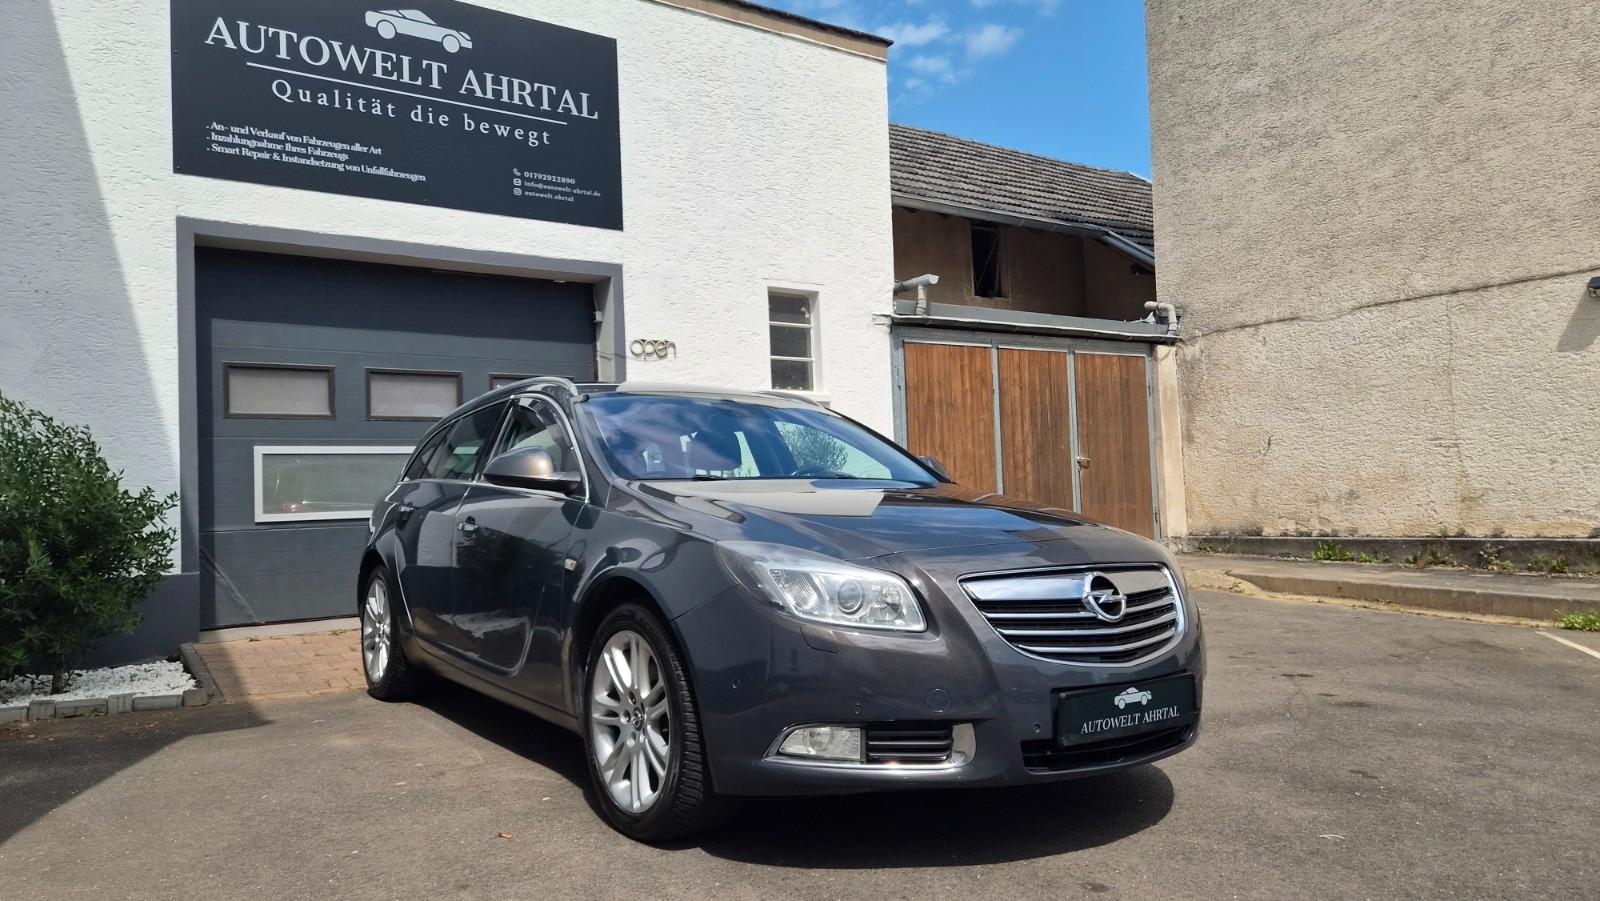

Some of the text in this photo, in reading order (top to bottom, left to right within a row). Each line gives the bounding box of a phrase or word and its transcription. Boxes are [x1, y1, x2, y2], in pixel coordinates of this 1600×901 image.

[205, 17, 599, 120] AUTOWELT AHRTAL
[271, 79, 550, 147] Qualität die bewegt
[210, 131, 349, 161] Inzahlungnahme Ihres Fahrzeugs
[230, 126, 249, 135] und
[249, 127, 287, 140] Verkauf
[286, 134, 302, 143] von
[302, 135, 350, 151] Fahrzeugen
[351, 142, 369, 153] aller
[368, 146, 383, 155] Art
[211, 143, 240, 155] Smart
[241, 147, 272, 160] Repair
[282, 153, 344, 172] Instandsetzung
[345, 164, 361, 172] von
[1080, 705, 1180, 735] AUTOWELT AHRTAL
